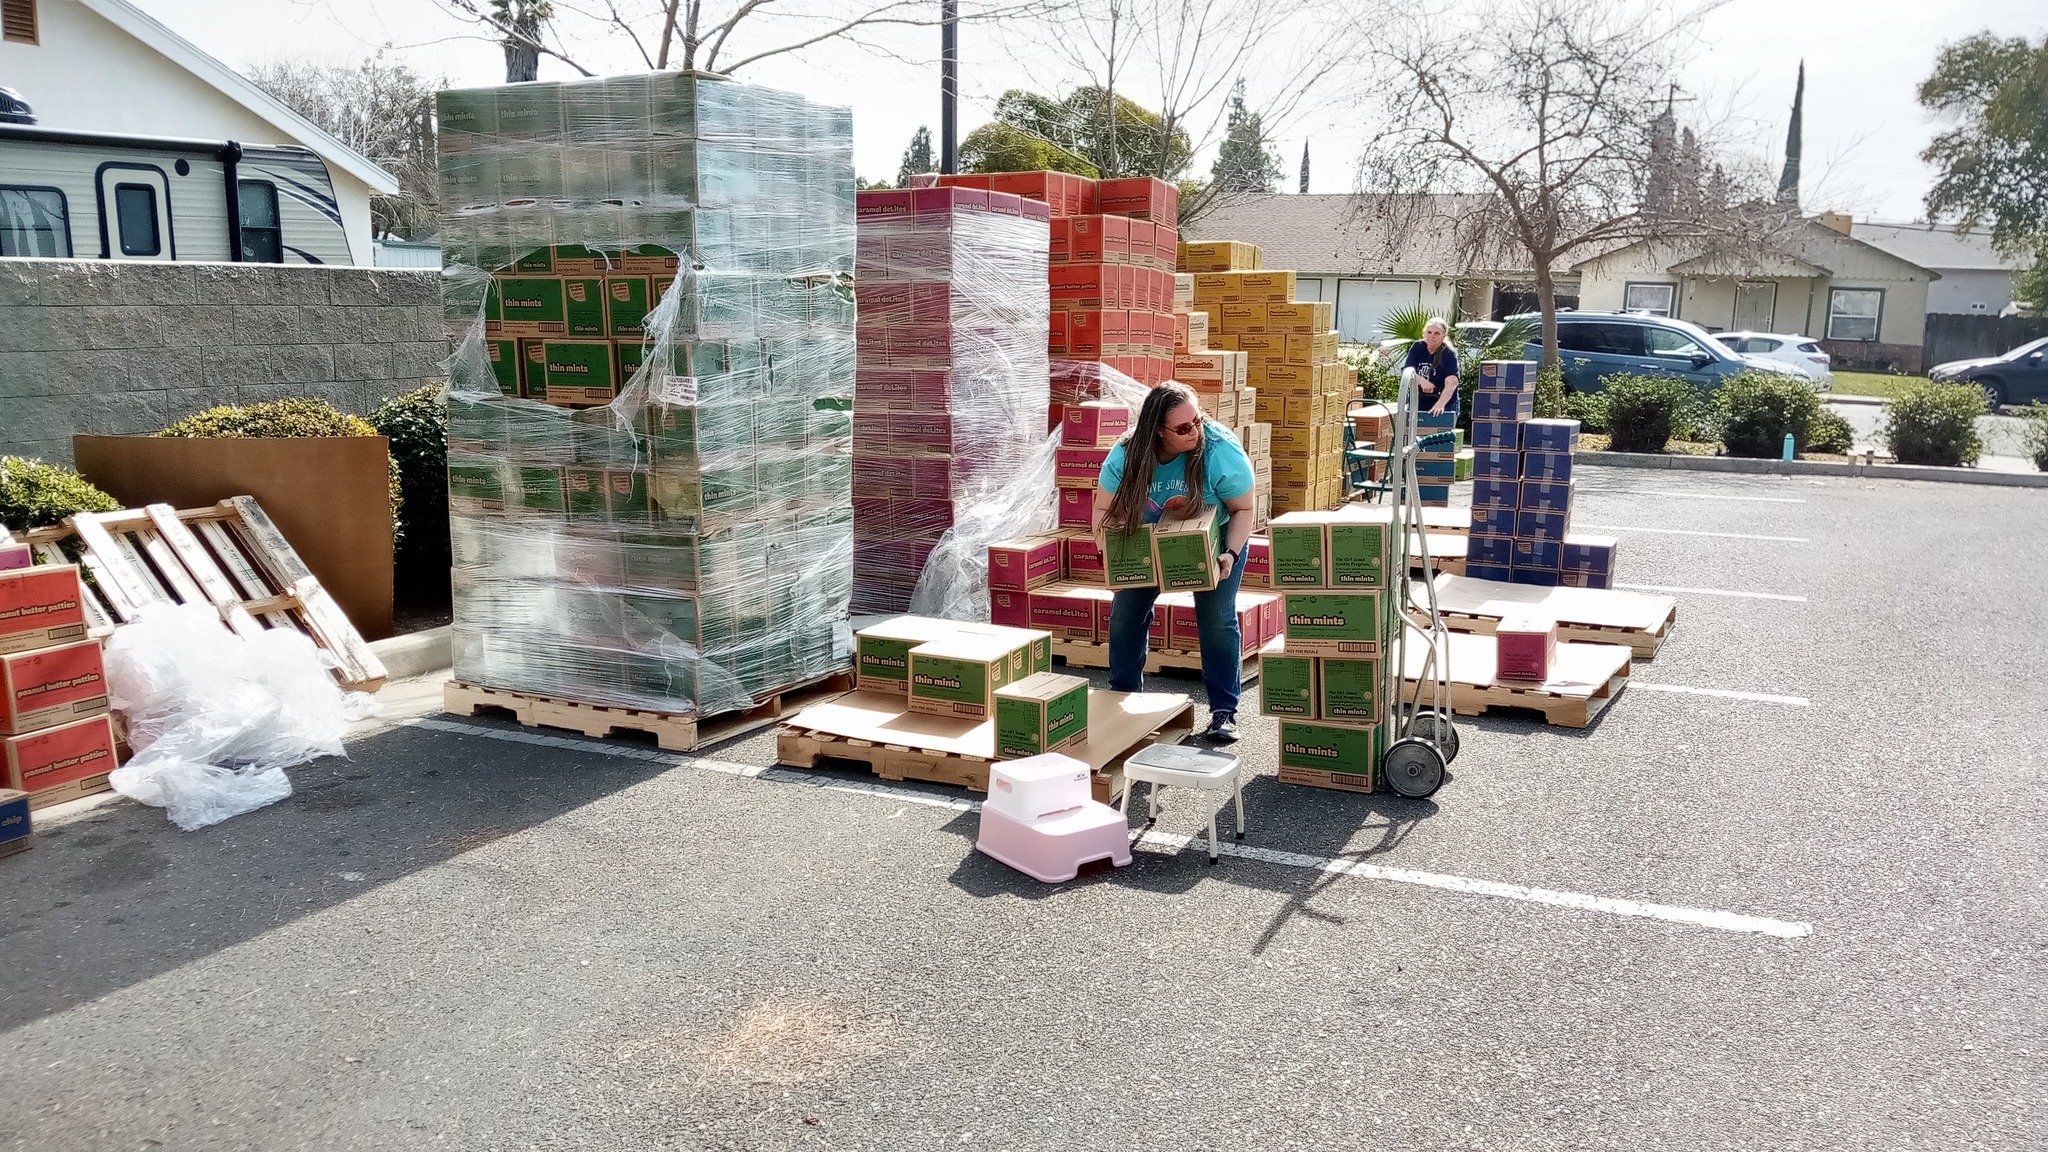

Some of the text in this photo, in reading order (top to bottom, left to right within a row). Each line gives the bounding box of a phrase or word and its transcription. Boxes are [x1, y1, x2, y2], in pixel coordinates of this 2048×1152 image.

[882, 205, 907, 213] deLites
[505, 299, 542, 307] thin mints
[549, 363, 588, 373] thin mints
[1060, 461, 1088, 469] caramel
[452, 475, 487, 485] thin mints
[1147, 481, 1162, 493] OVE
[1028, 559, 1044, 570] caramel
[1116, 573, 1147, 582] thin mints
[1184, 579, 1203, 587] mints
[0, 601, 77, 619] eanut butter patties
[1033, 607, 1088, 618] caramel deLites
[1176, 619, 1198, 627] caram
[1289, 614, 1345, 626] thin mints
[862, 655, 906, 667] thin mints
[17, 673, 99, 700] peanut butter patties
[914, 674, 960, 688] thin mints
[1285, 705, 1304, 713] mints
[1048, 712, 1074, 732] thin mints
[1003, 746, 1034, 756] thin mints
[1284, 743, 1338, 758] thin mints
[23, 749, 108, 779] peanut butter patties
